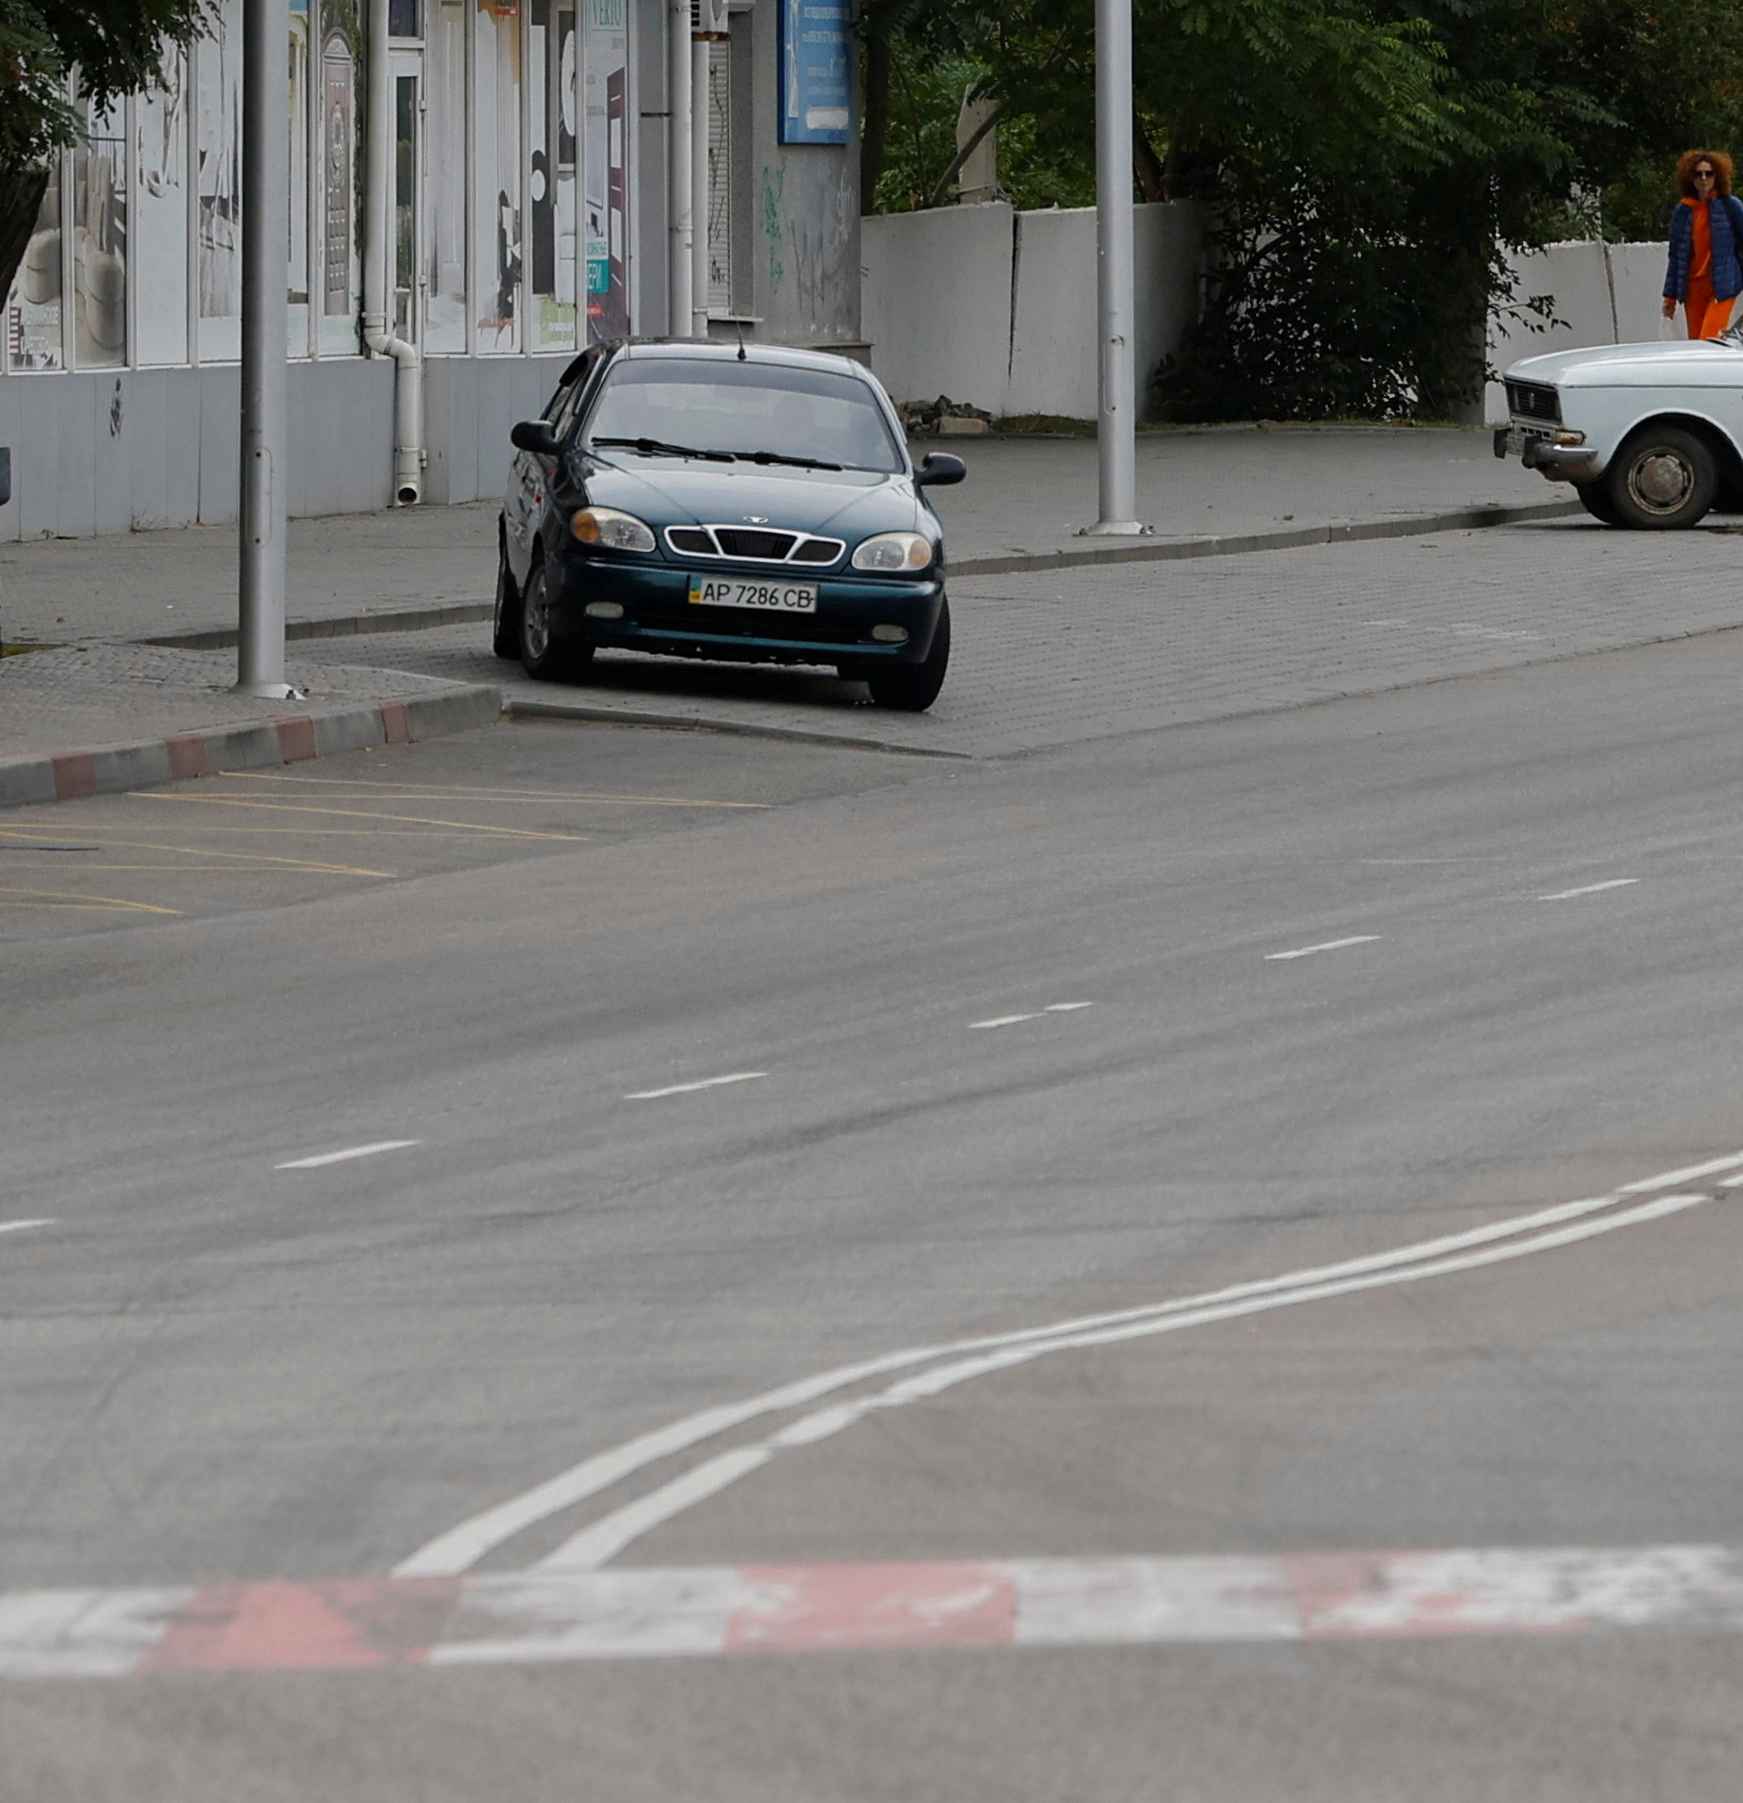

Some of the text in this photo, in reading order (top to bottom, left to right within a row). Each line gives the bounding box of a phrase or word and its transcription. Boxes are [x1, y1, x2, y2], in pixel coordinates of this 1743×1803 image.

[703, 583, 815, 609] AP 7286 CB
